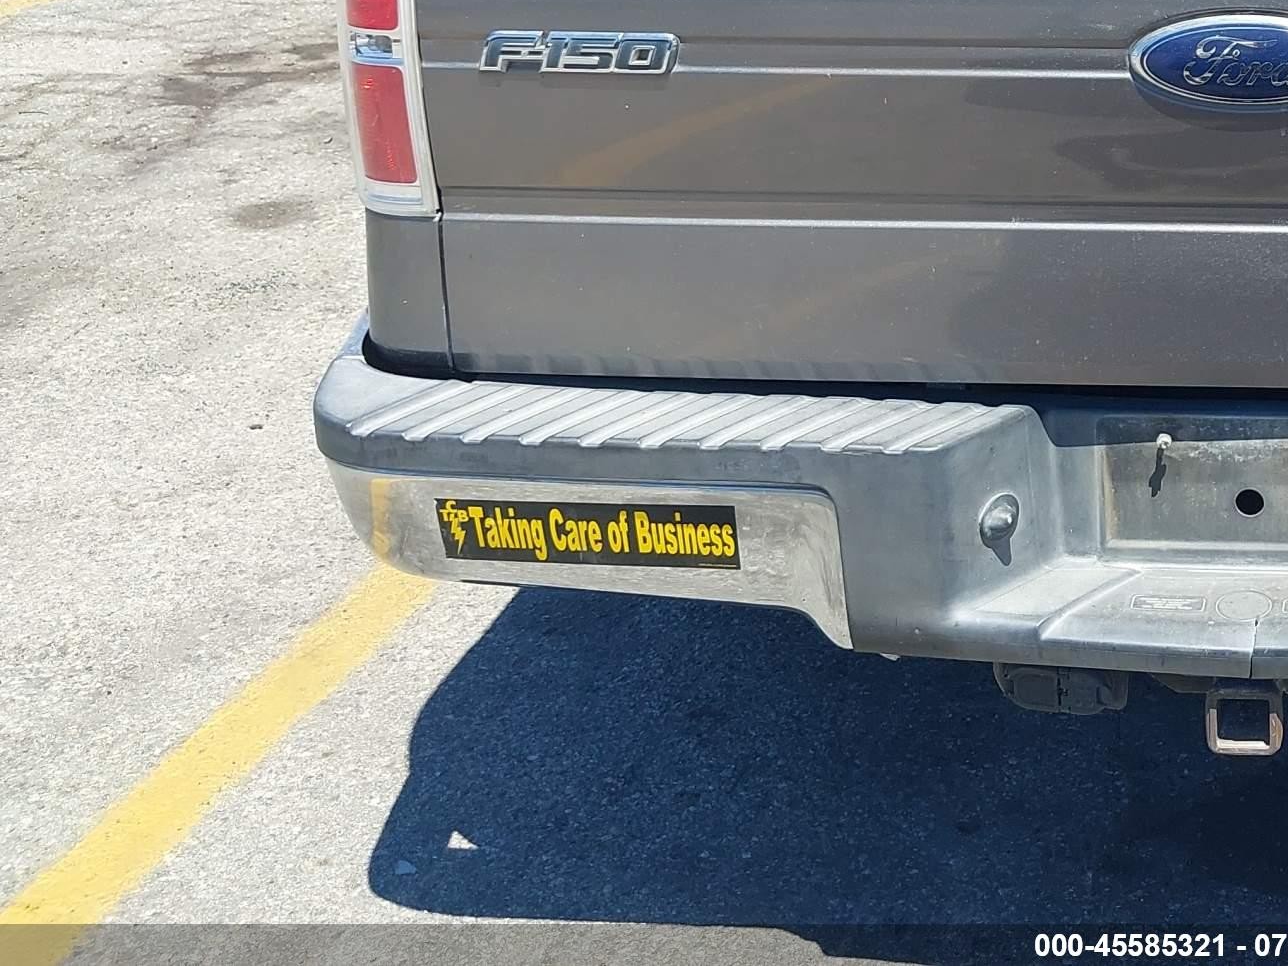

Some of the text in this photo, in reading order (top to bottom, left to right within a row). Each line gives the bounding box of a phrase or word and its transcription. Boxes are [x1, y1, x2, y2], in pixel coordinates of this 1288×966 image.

[479, 30, 681, 74] F-150
[467, 506, 735, 561] Taking Care of Business
